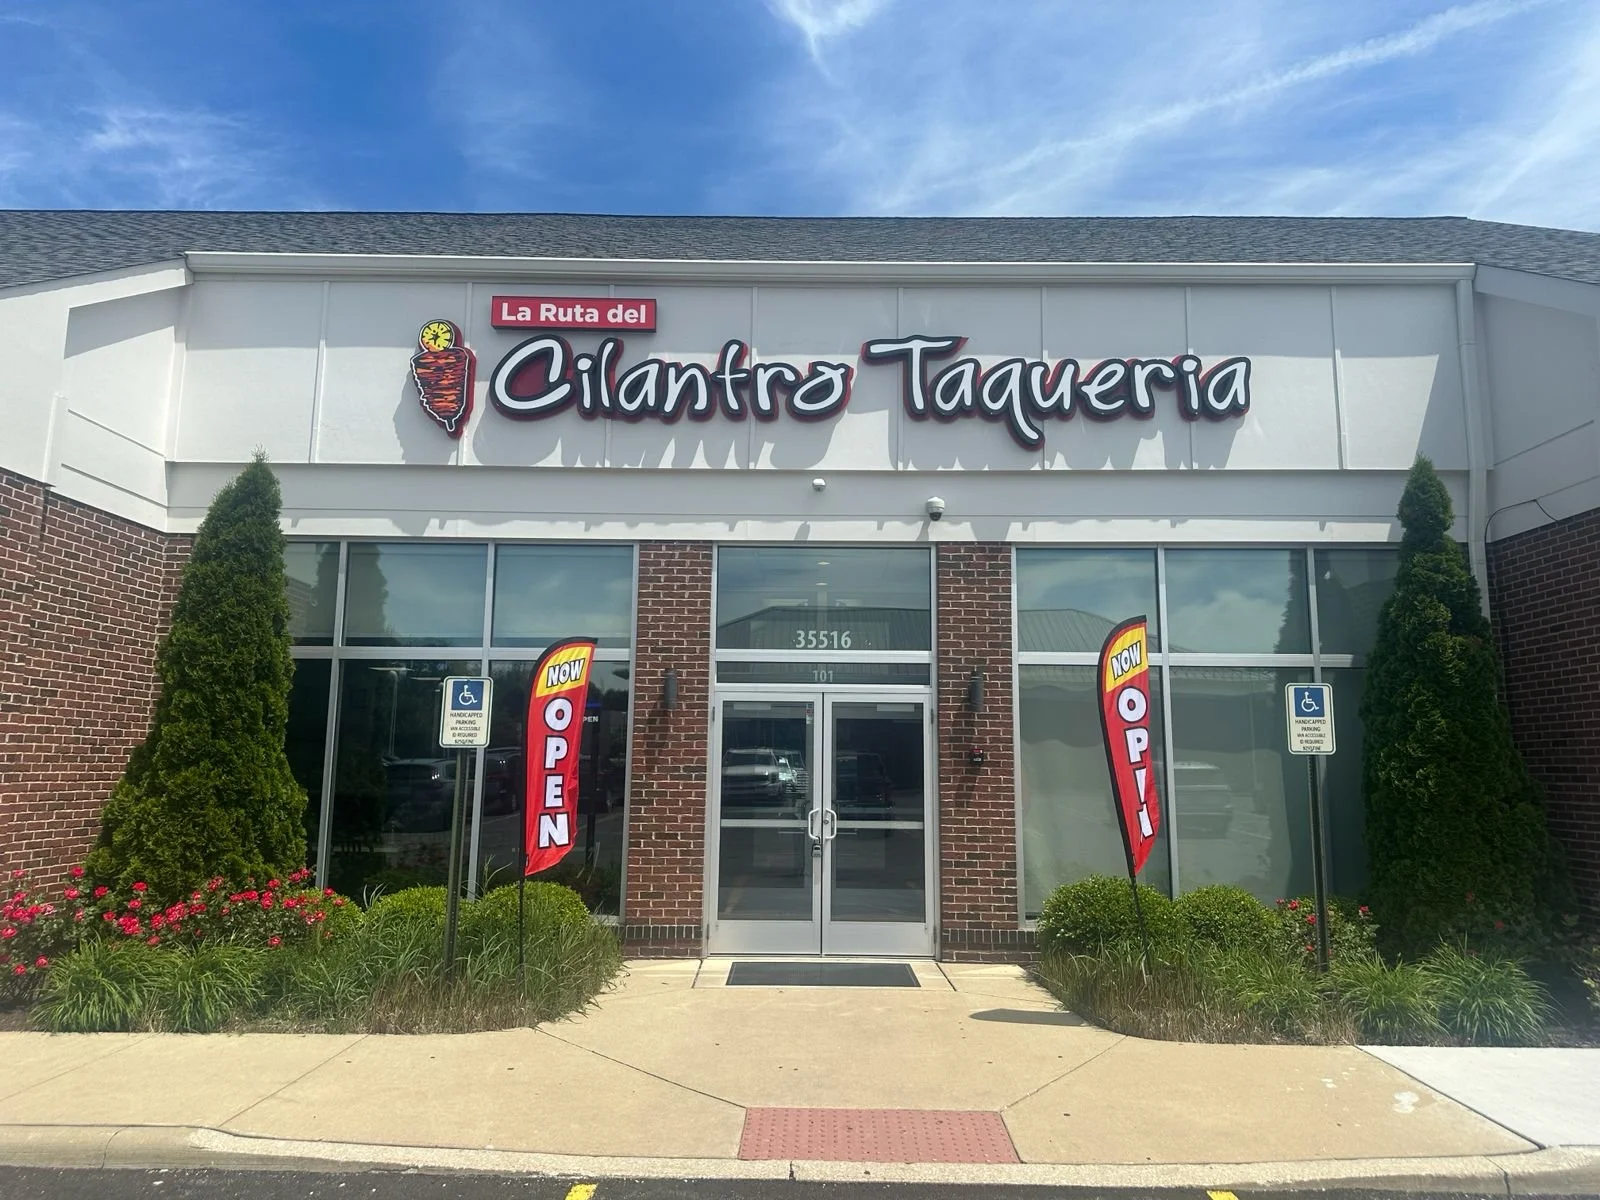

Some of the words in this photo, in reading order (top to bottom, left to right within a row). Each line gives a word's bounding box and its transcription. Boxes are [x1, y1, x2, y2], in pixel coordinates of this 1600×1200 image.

[501, 302, 532, 321] La
[539, 303, 599, 322] Ruta
[606, 304, 646, 323] del
[491, 334, 852, 420] Cilantro
[863, 335, 1250, 446] Taqueria
[795, 630, 852, 649] 35516
[1111, 640, 1142, 680] NOW
[546, 658, 585, 688] NOW
[812, 670, 834, 682] 101
[583, 715, 599, 723] PEN
[538, 696, 573, 848] OPEN
